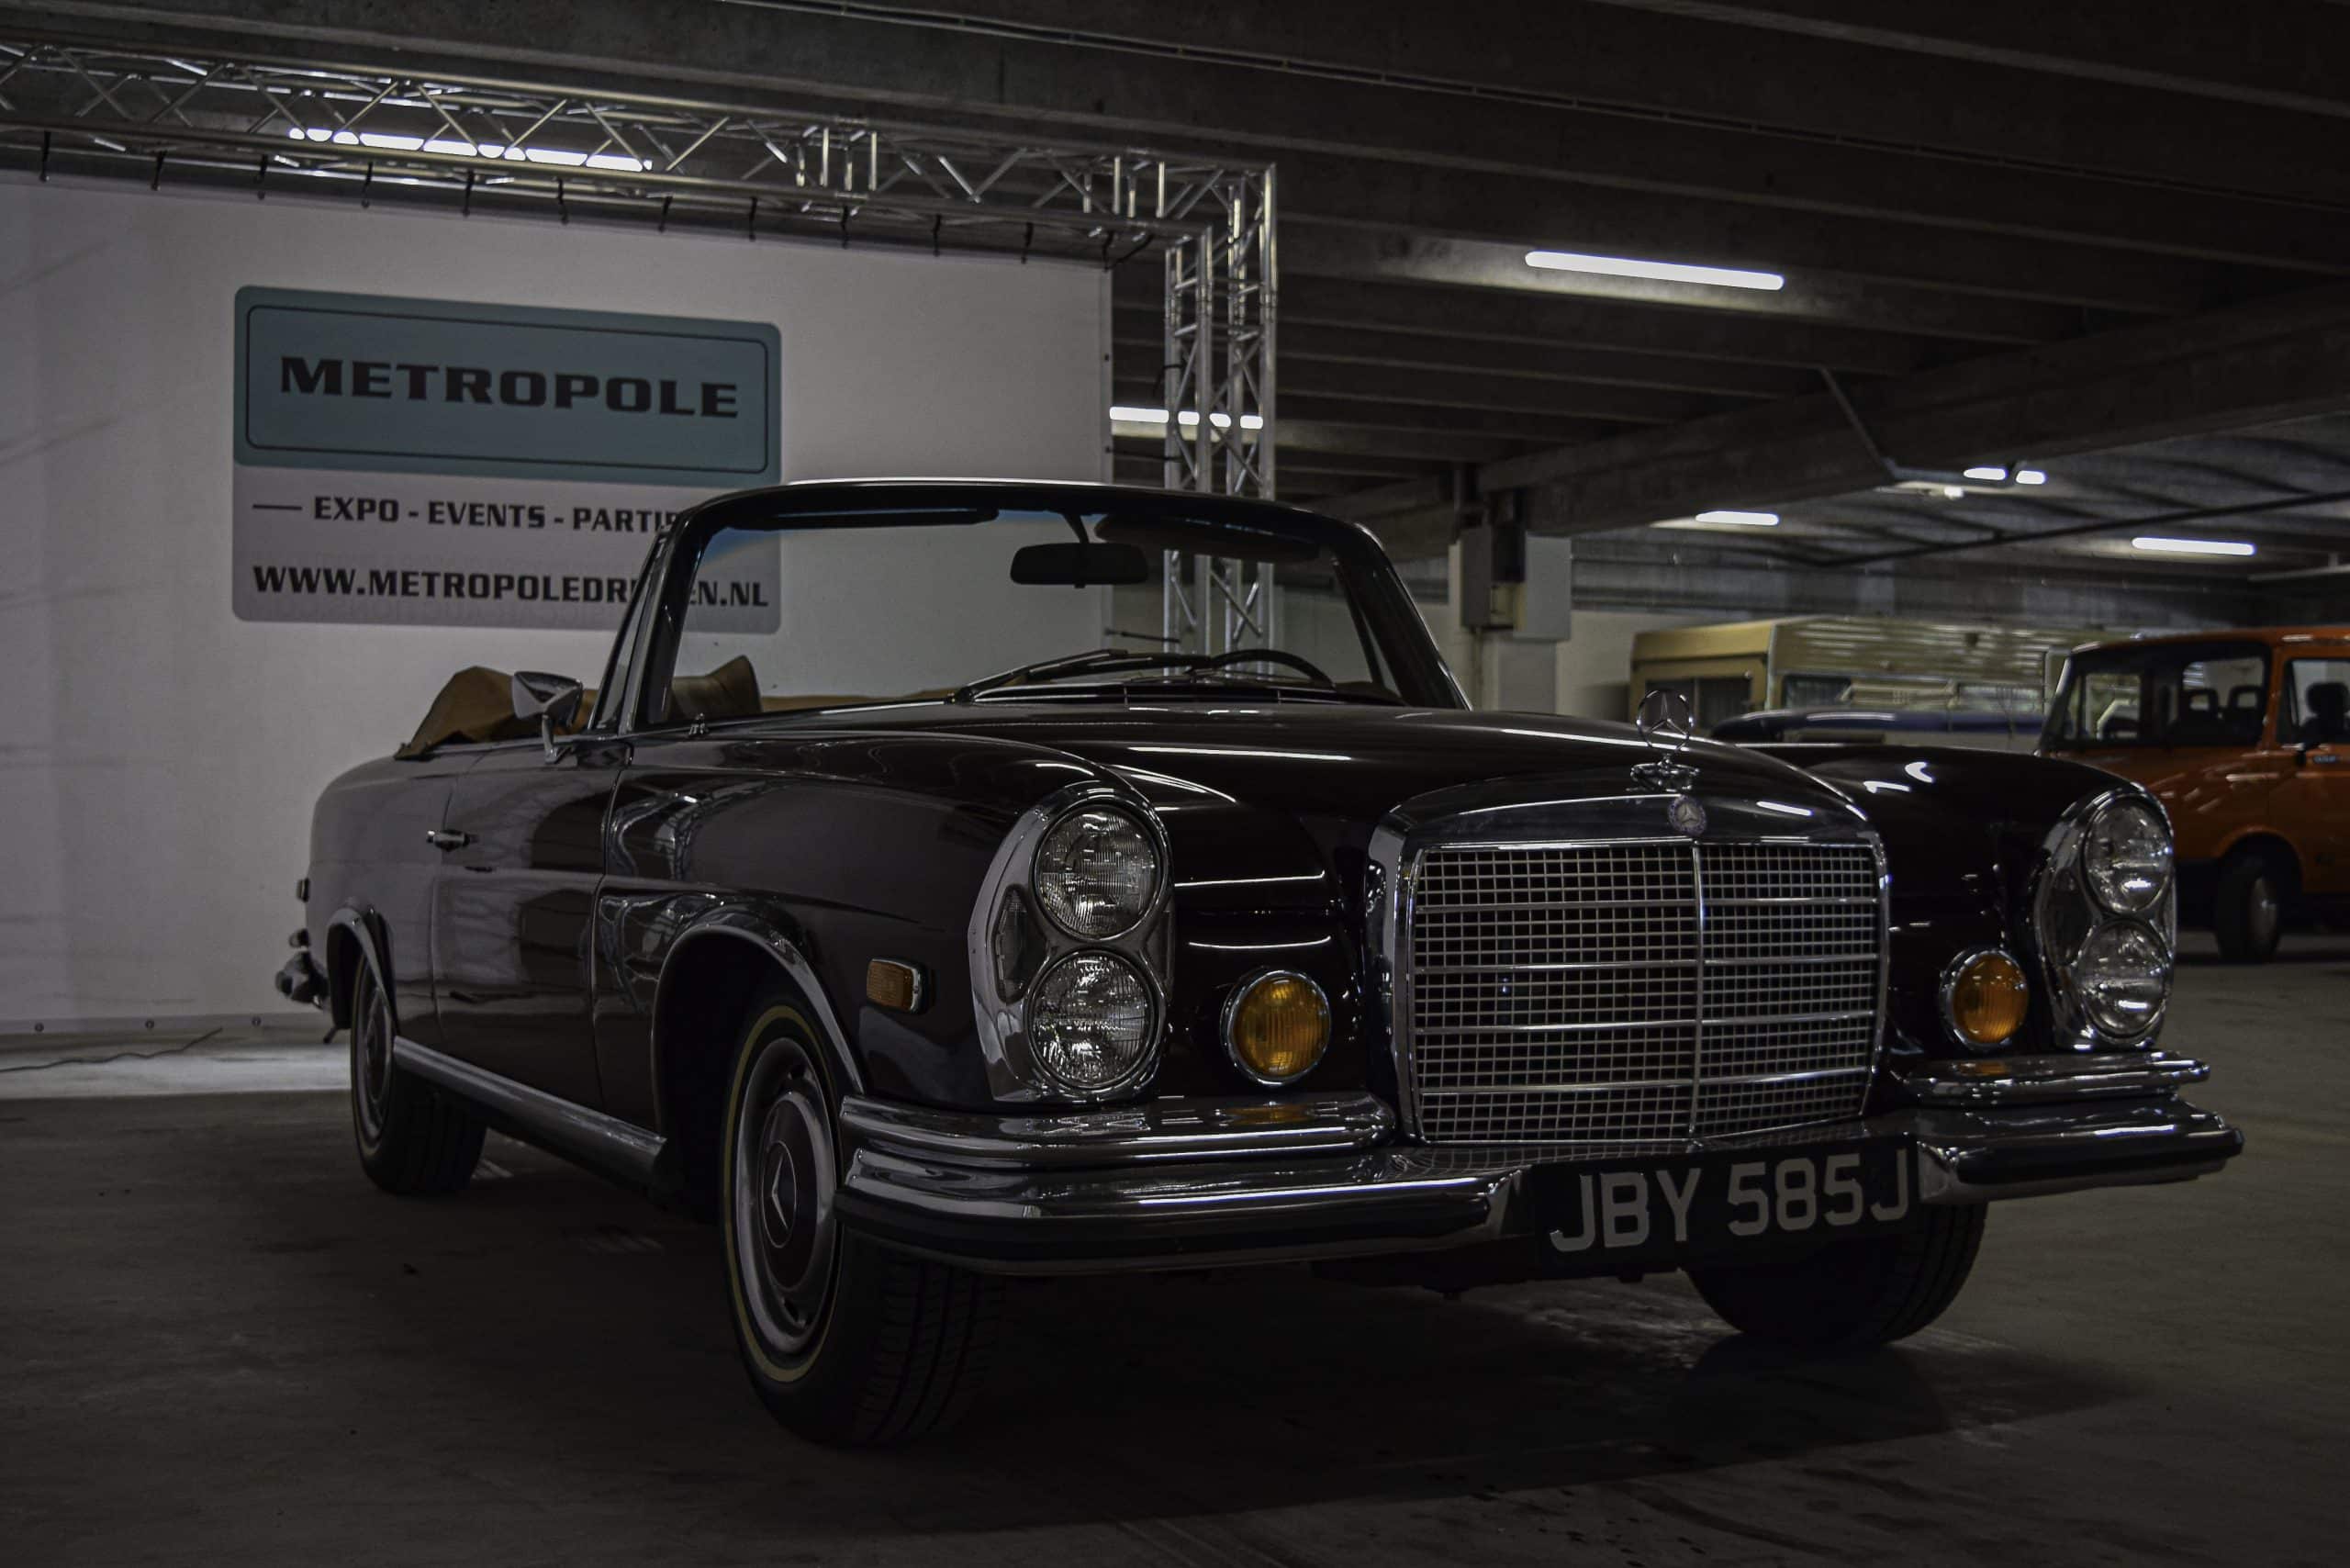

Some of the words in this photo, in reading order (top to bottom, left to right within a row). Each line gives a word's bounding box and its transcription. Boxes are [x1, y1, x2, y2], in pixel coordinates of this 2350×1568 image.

[280, 355, 740, 419] METROPOLE
[314, 496, 399, 522] EXPO
[428, 501, 545, 530] EVENTS
[1550, 1167, 1702, 1253] JBY
[1726, 1147, 1908, 1238] 585J
